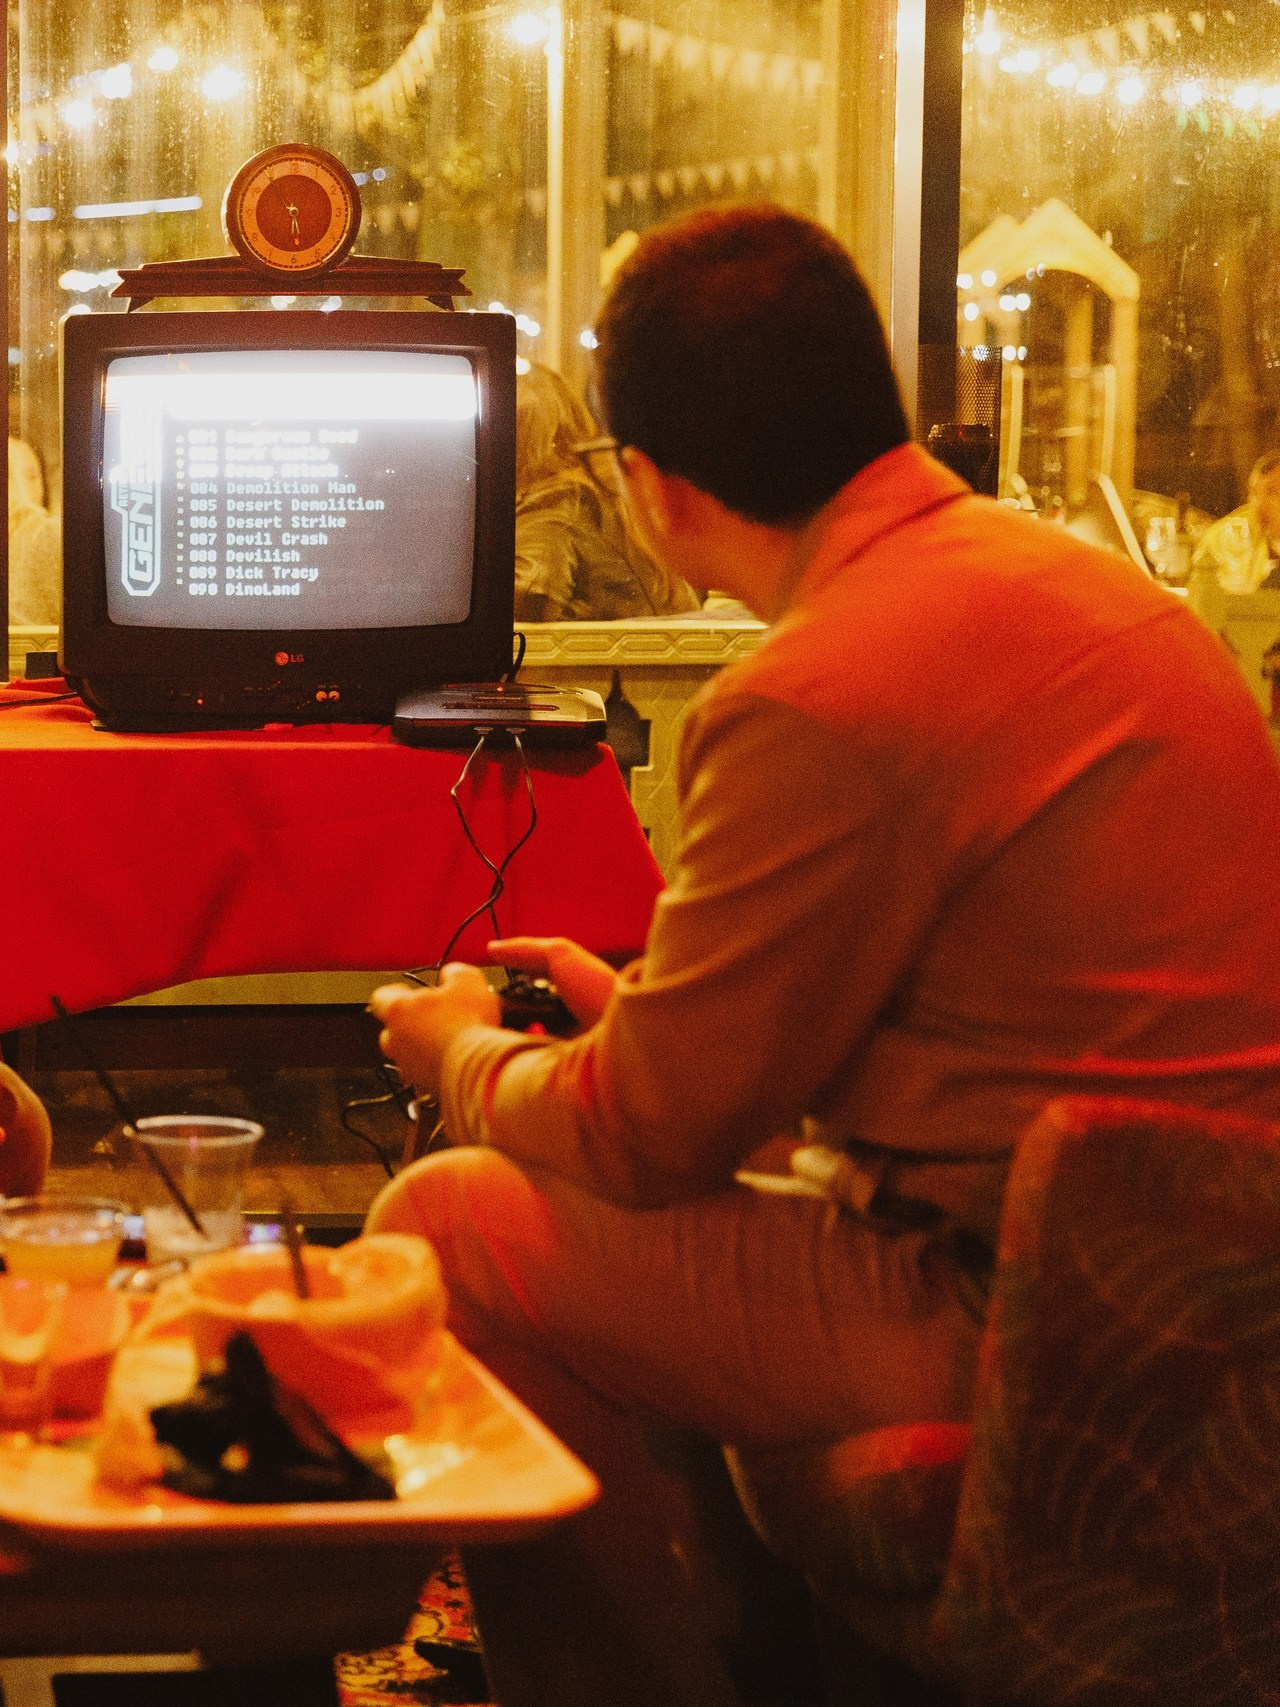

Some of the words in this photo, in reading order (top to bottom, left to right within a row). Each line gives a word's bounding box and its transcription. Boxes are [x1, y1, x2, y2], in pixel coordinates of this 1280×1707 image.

[189, 482, 218, 494] 084
[226, 481, 319, 494] Demolition
[327, 481, 356, 494] Man
[189, 498, 218, 512] 085
[226, 498, 283, 512] Desert
[291, 497, 386, 511] Demolition
[189, 516, 218, 528] 086
[226, 515, 283, 528] Desert
[290, 515, 347, 528] Strike
[189, 532, 217, 545] 087
[226, 532, 273, 545] Devil
[281, 532, 328, 545] Crash
[189, 549, 217, 562] 088
[225, 549, 301, 562] Devilish
[188, 566, 217, 579] 089
[225, 566, 264, 579] Dick
[272, 566, 319, 582] Tracy
[188, 583, 218, 595] 090
[225, 582, 301, 595] DinoLand
